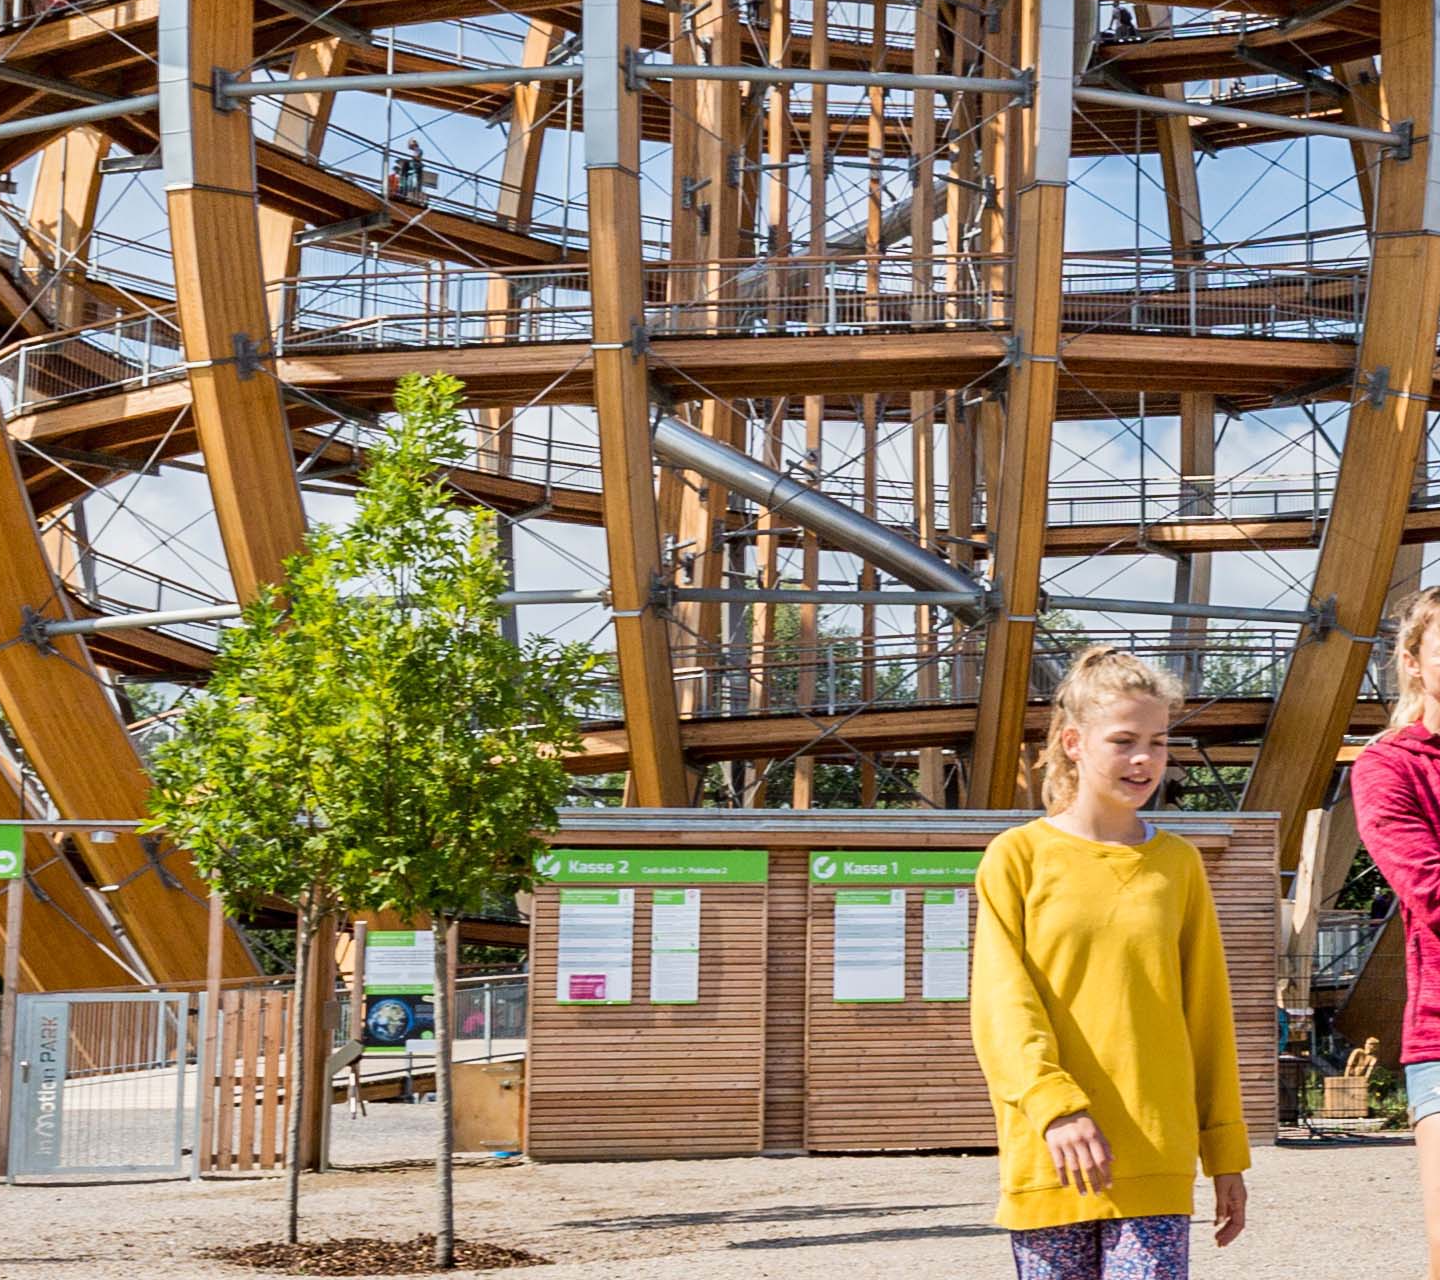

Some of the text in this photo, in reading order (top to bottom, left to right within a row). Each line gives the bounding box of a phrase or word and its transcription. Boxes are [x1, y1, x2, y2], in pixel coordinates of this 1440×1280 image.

[568, 860, 630, 874] Kasse 2
[843, 862, 898, 875] Kasse 1
[39, 1016, 58, 1063] PARK
